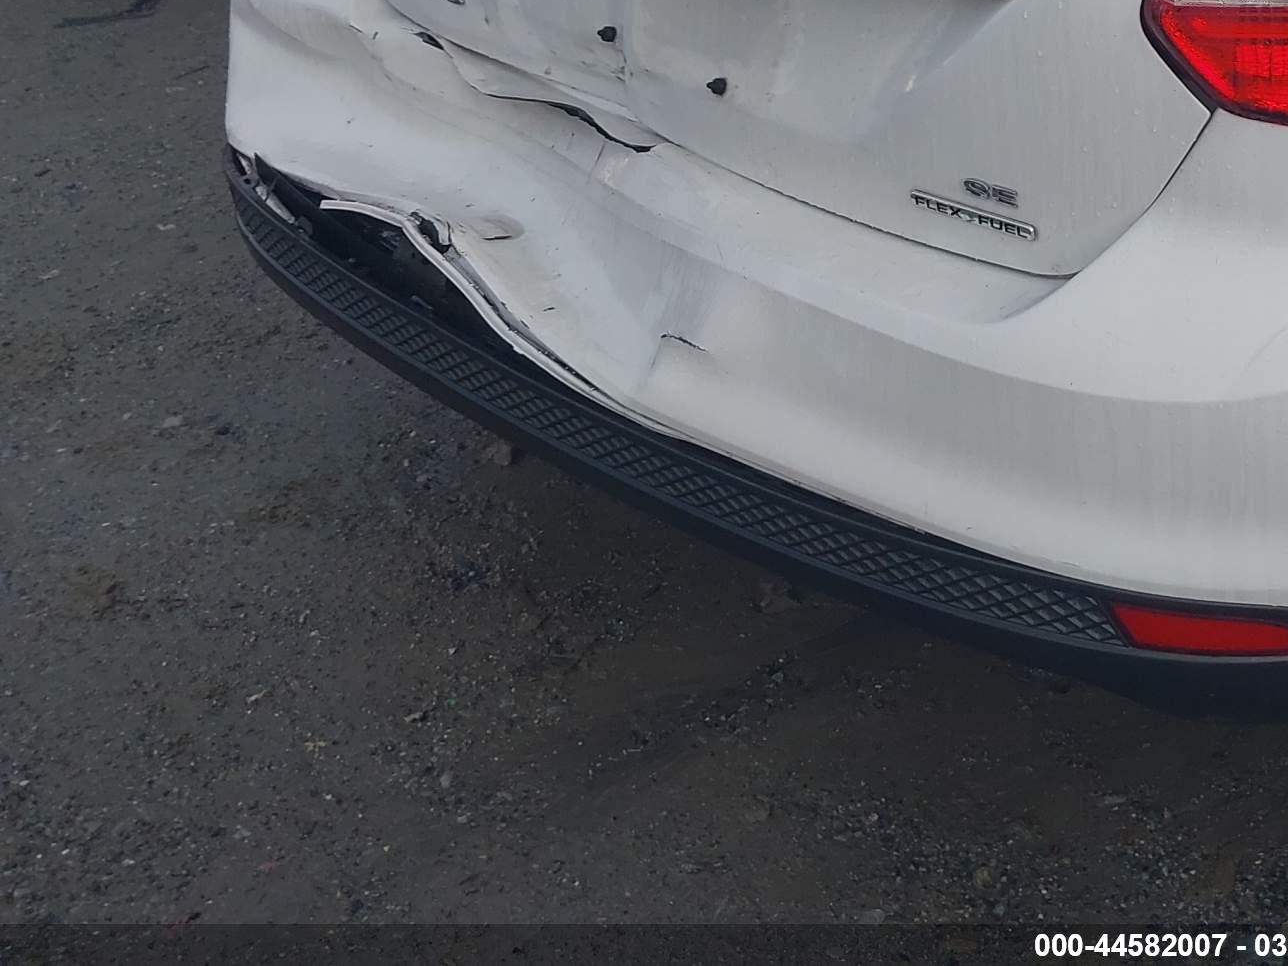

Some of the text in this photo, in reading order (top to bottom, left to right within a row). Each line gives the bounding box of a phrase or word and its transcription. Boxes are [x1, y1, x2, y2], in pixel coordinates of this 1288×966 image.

[962, 177, 1018, 208] SE
[912, 194, 1032, 240] FLEX FUEL
